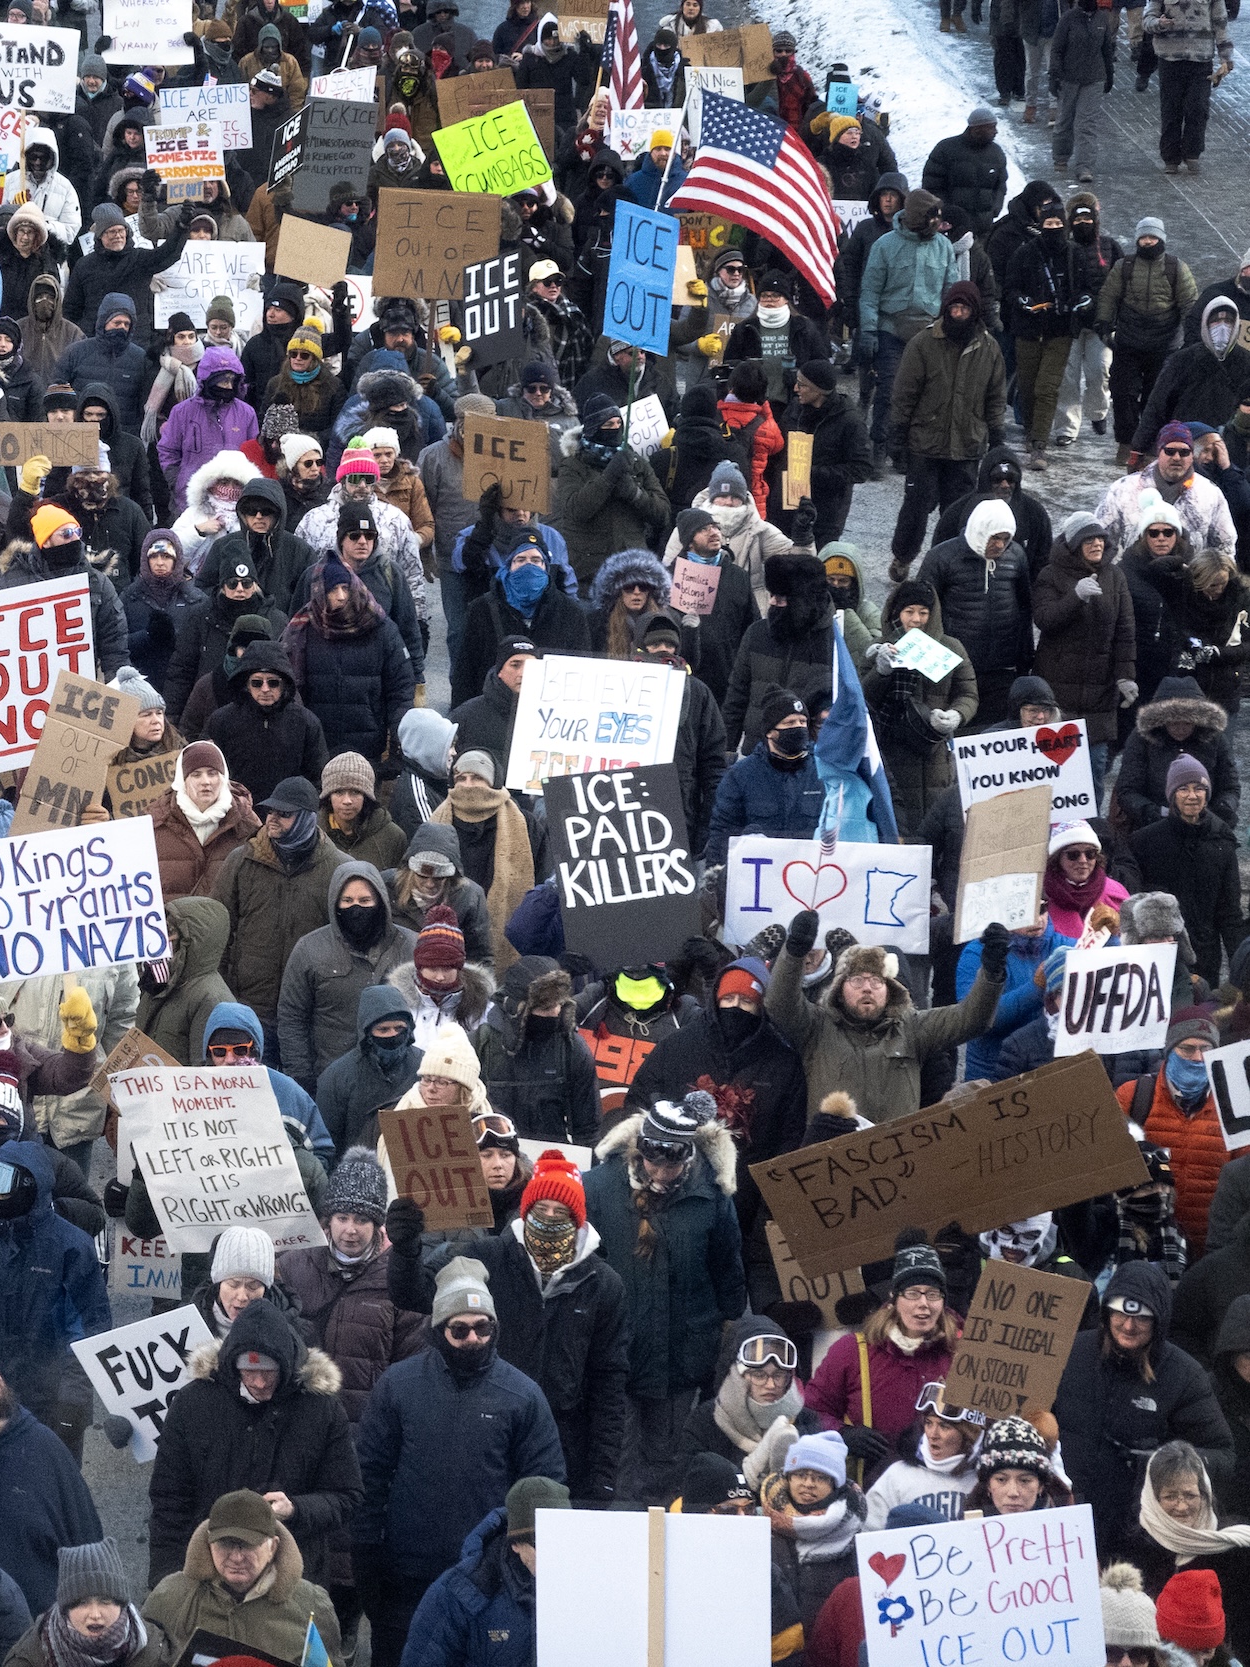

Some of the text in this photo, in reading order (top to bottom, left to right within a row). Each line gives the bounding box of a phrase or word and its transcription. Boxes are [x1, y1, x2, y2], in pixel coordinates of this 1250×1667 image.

[1, 67, 42, 80] WITH
[160, 87, 249, 109] ICE AGENTS
[186, 109, 218, 122] ARE
[280, 114, 303, 145] ICE
[614, 110, 672, 129] NO ICE
[146, 123, 212, 142] TRUMP &
[462, 115, 516, 159] ICE
[147, 151, 218, 164] DOMESTIC
[273, 146, 302, 174] AMERICAN
[274, 156, 300, 182] GESTAPO
[397, 202, 485, 233] ICE
[625, 214, 672, 272] ICE
[178, 252, 251, 274] ARE WE
[464, 252, 520, 303] ICE
[184, 278, 249, 299] GREAT
[464, 291, 520, 342] OUT
[610, 281, 668, 338] OUT
[473, 433, 527, 463] ICE
[631, 424, 662, 448] OUT
[479, 471, 540, 505] OUT!
[679, 581, 705, 602] belong
[680, 567, 709, 586] families
[54, 682, 121, 731] ICE
[59, 726, 106, 759] OUT
[958, 733, 1084, 760] IN YOUR HEART
[60, 755, 88, 775] OF
[970, 764, 1061, 790] YOU KNOW
[571, 771, 651, 815] ICE:
[564, 810, 673, 859] PAID
[558, 848, 697, 909] KILLERS
[59, 910, 168, 972] NAZIS
[171, 1095, 237, 1114] MOMENT.
[163, 1118, 239, 1141] IT IS NOT
[398, 1113, 470, 1163] ICE
[145, 1144, 285, 1176] LEFT OR RIGHT
[199, 1173, 240, 1194] IT IS
[982, 1278, 1064, 1321] NO ONE
[963, 1315, 1058, 1357] IS ILLEGAL
[955, 1353, 1030, 1389] ON STOLEN
[909, 1520, 1085, 1581] Be Pretti
[919, 1616, 1081, 1667] ICE OUT
